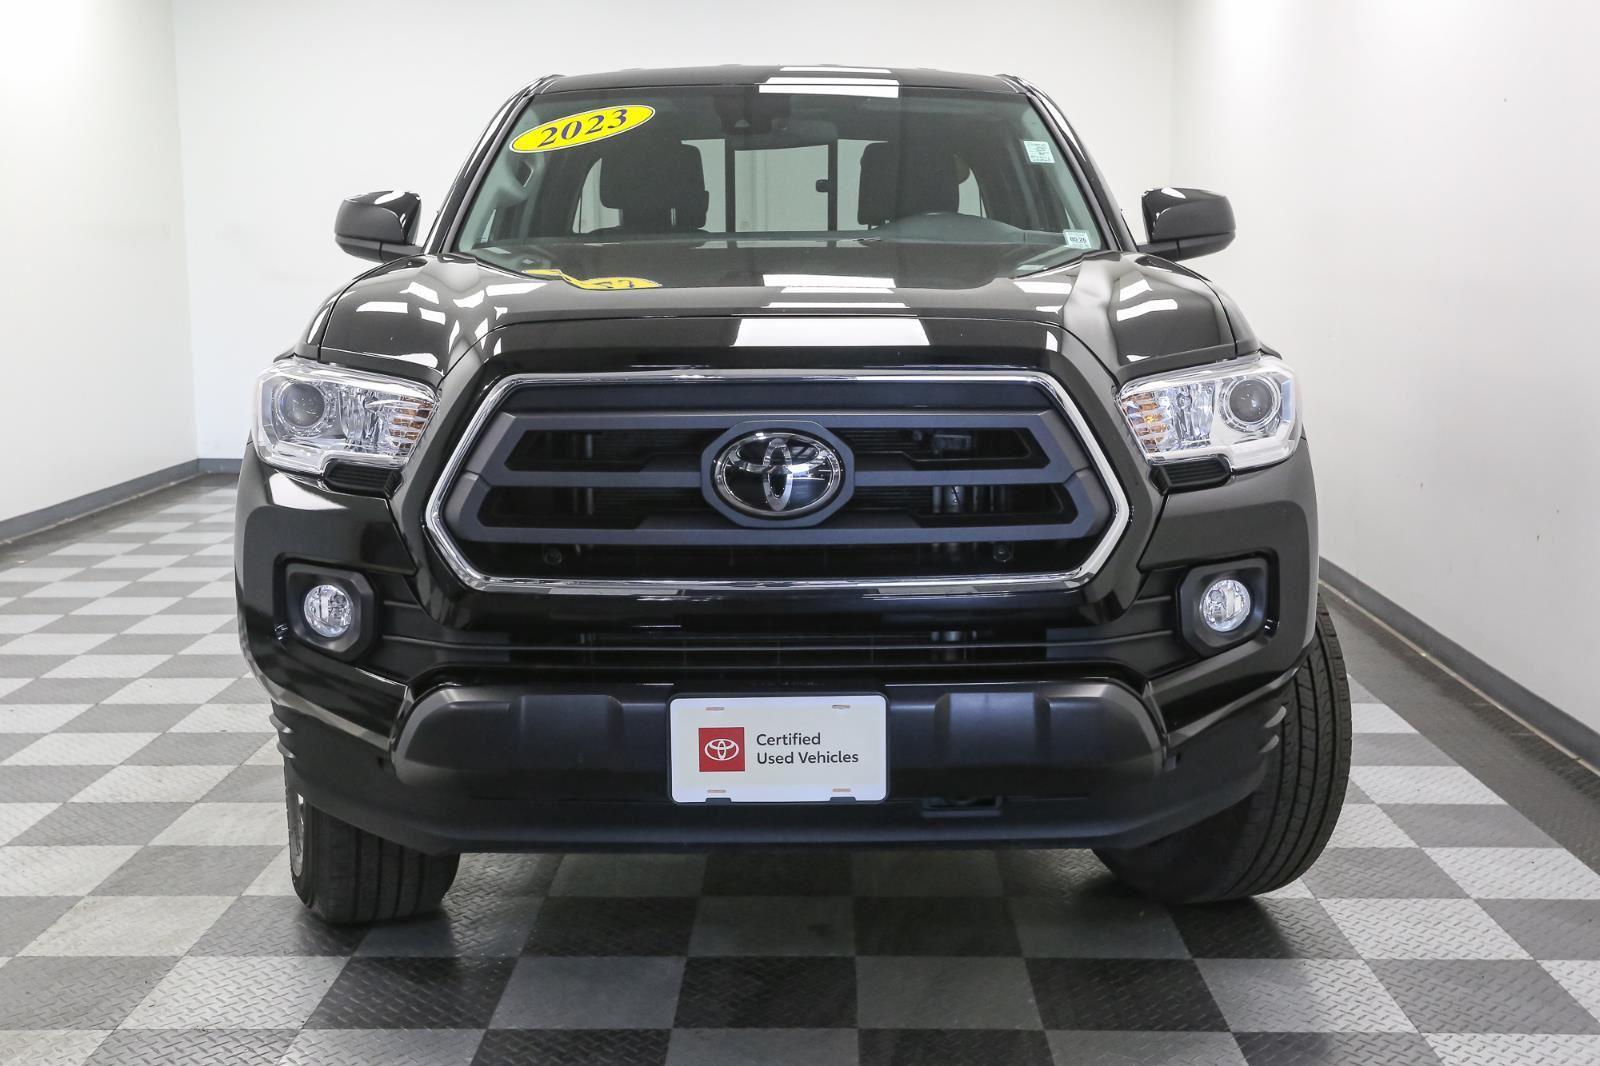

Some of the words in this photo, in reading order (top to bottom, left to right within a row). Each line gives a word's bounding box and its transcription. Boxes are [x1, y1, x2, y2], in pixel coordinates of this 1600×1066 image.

[536, 108, 628, 149] 2023
[756, 732, 821, 746] Certified
[757, 751, 794, 765] Used
[798, 750, 859, 764] Vehicles
